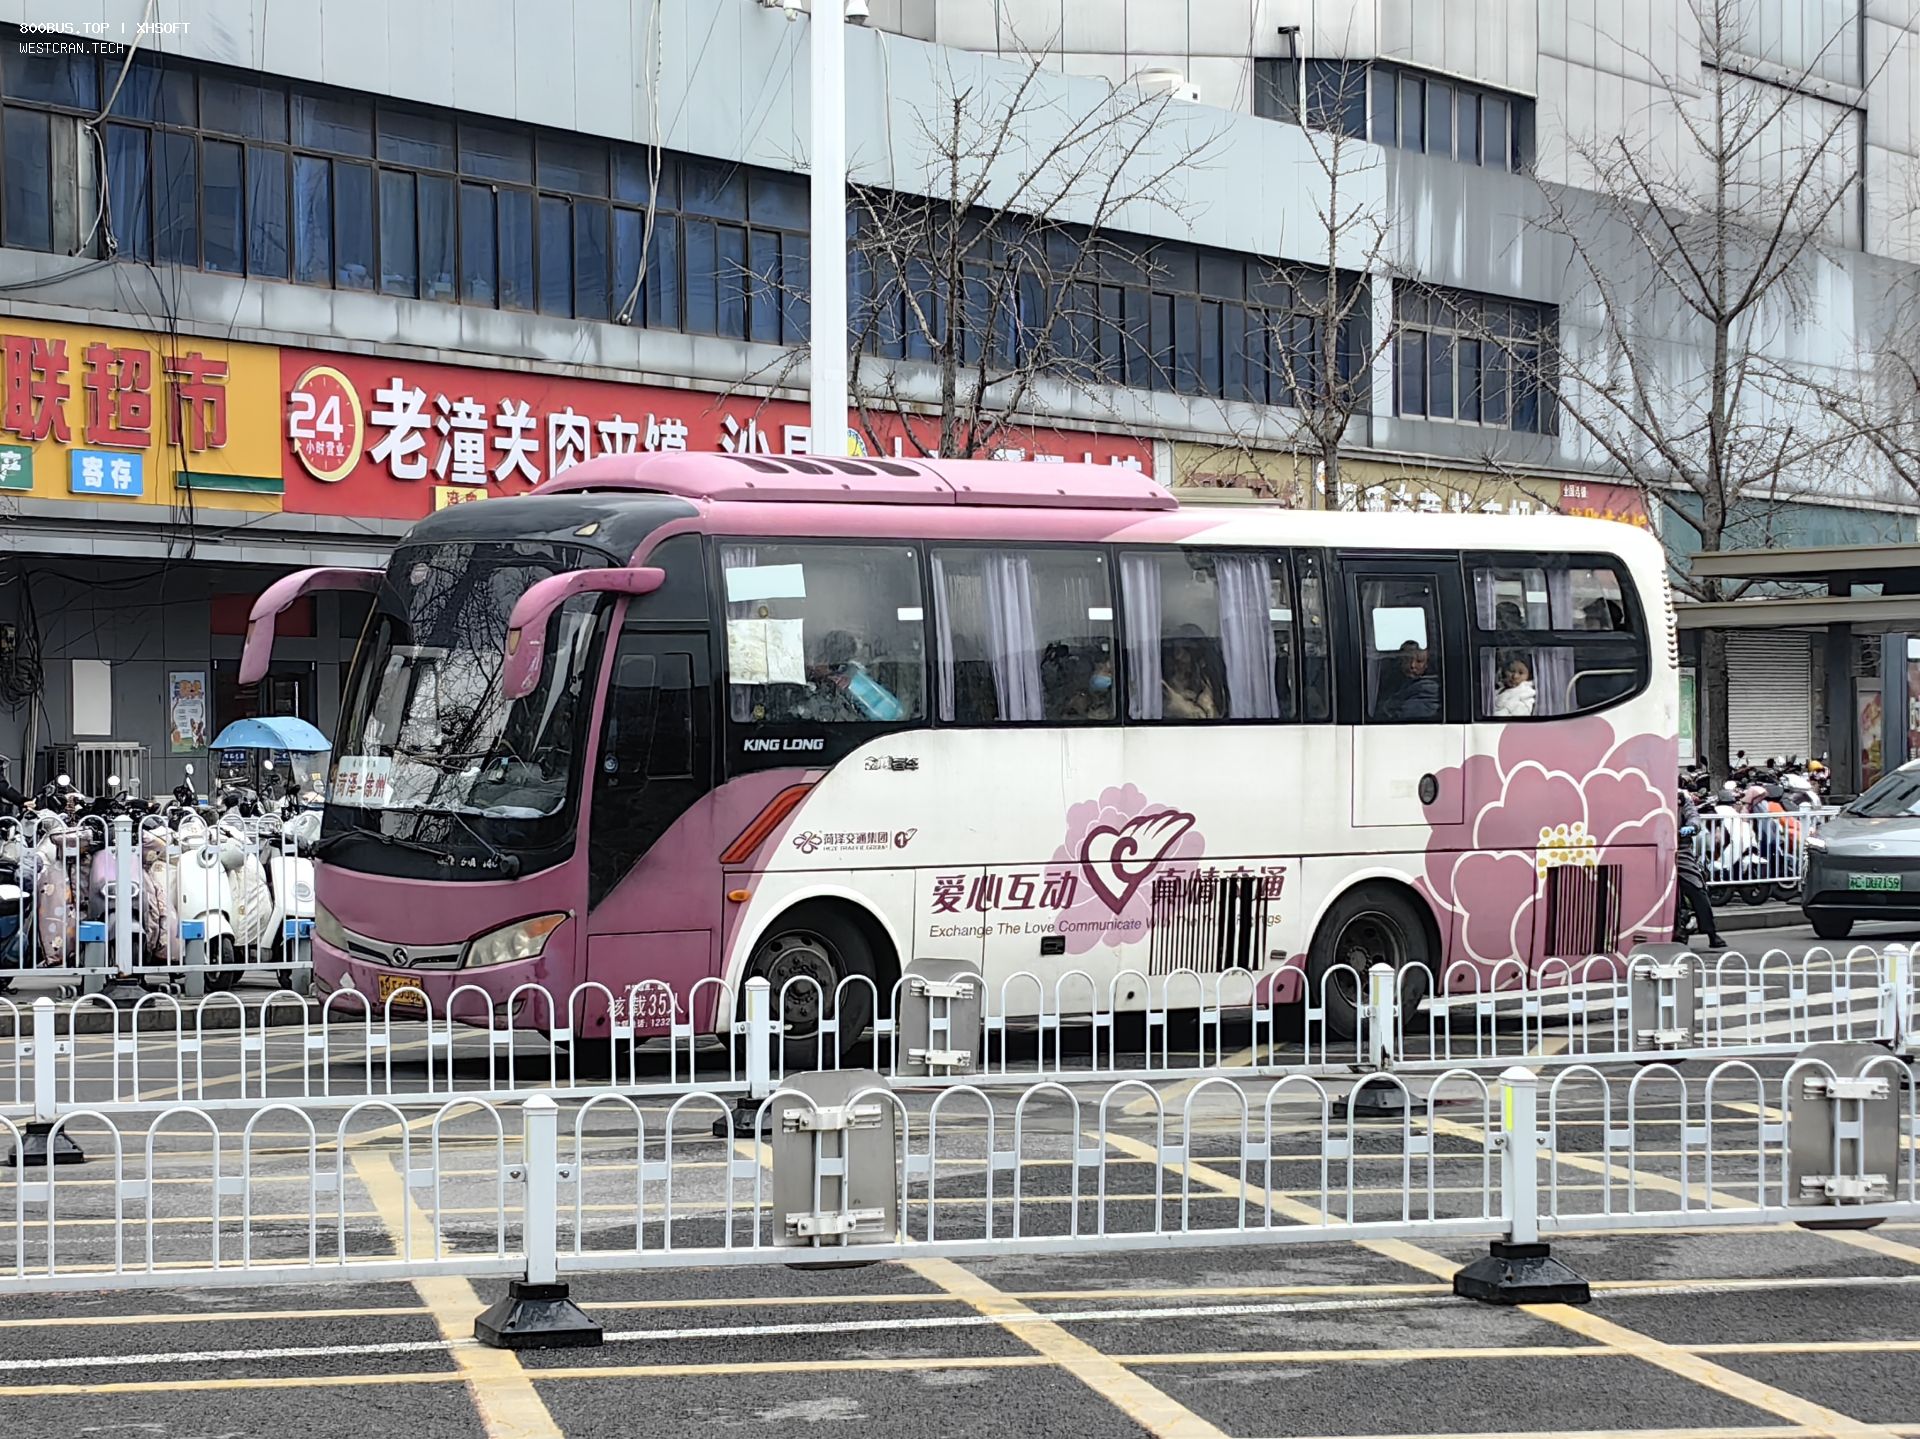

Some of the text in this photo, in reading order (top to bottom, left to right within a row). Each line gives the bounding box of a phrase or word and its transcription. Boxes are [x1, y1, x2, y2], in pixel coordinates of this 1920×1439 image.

[4, 335, 229, 453] 联超市
[290, 392, 343, 440] 24
[306, 440, 345, 457] 小时营业
[82, 456, 132, 489] 寄存
[744, 739, 824, 751] KING LONG
[823, 832, 888, 845] 菏泽交通集团
[931, 871, 1078, 914] 爱心互动
[930, 924, 993, 938] Exchange
[997, 923, 1021, 934] The
[1024, 921, 1055, 934] Love
[1058, 918, 1142, 932] Communicate
